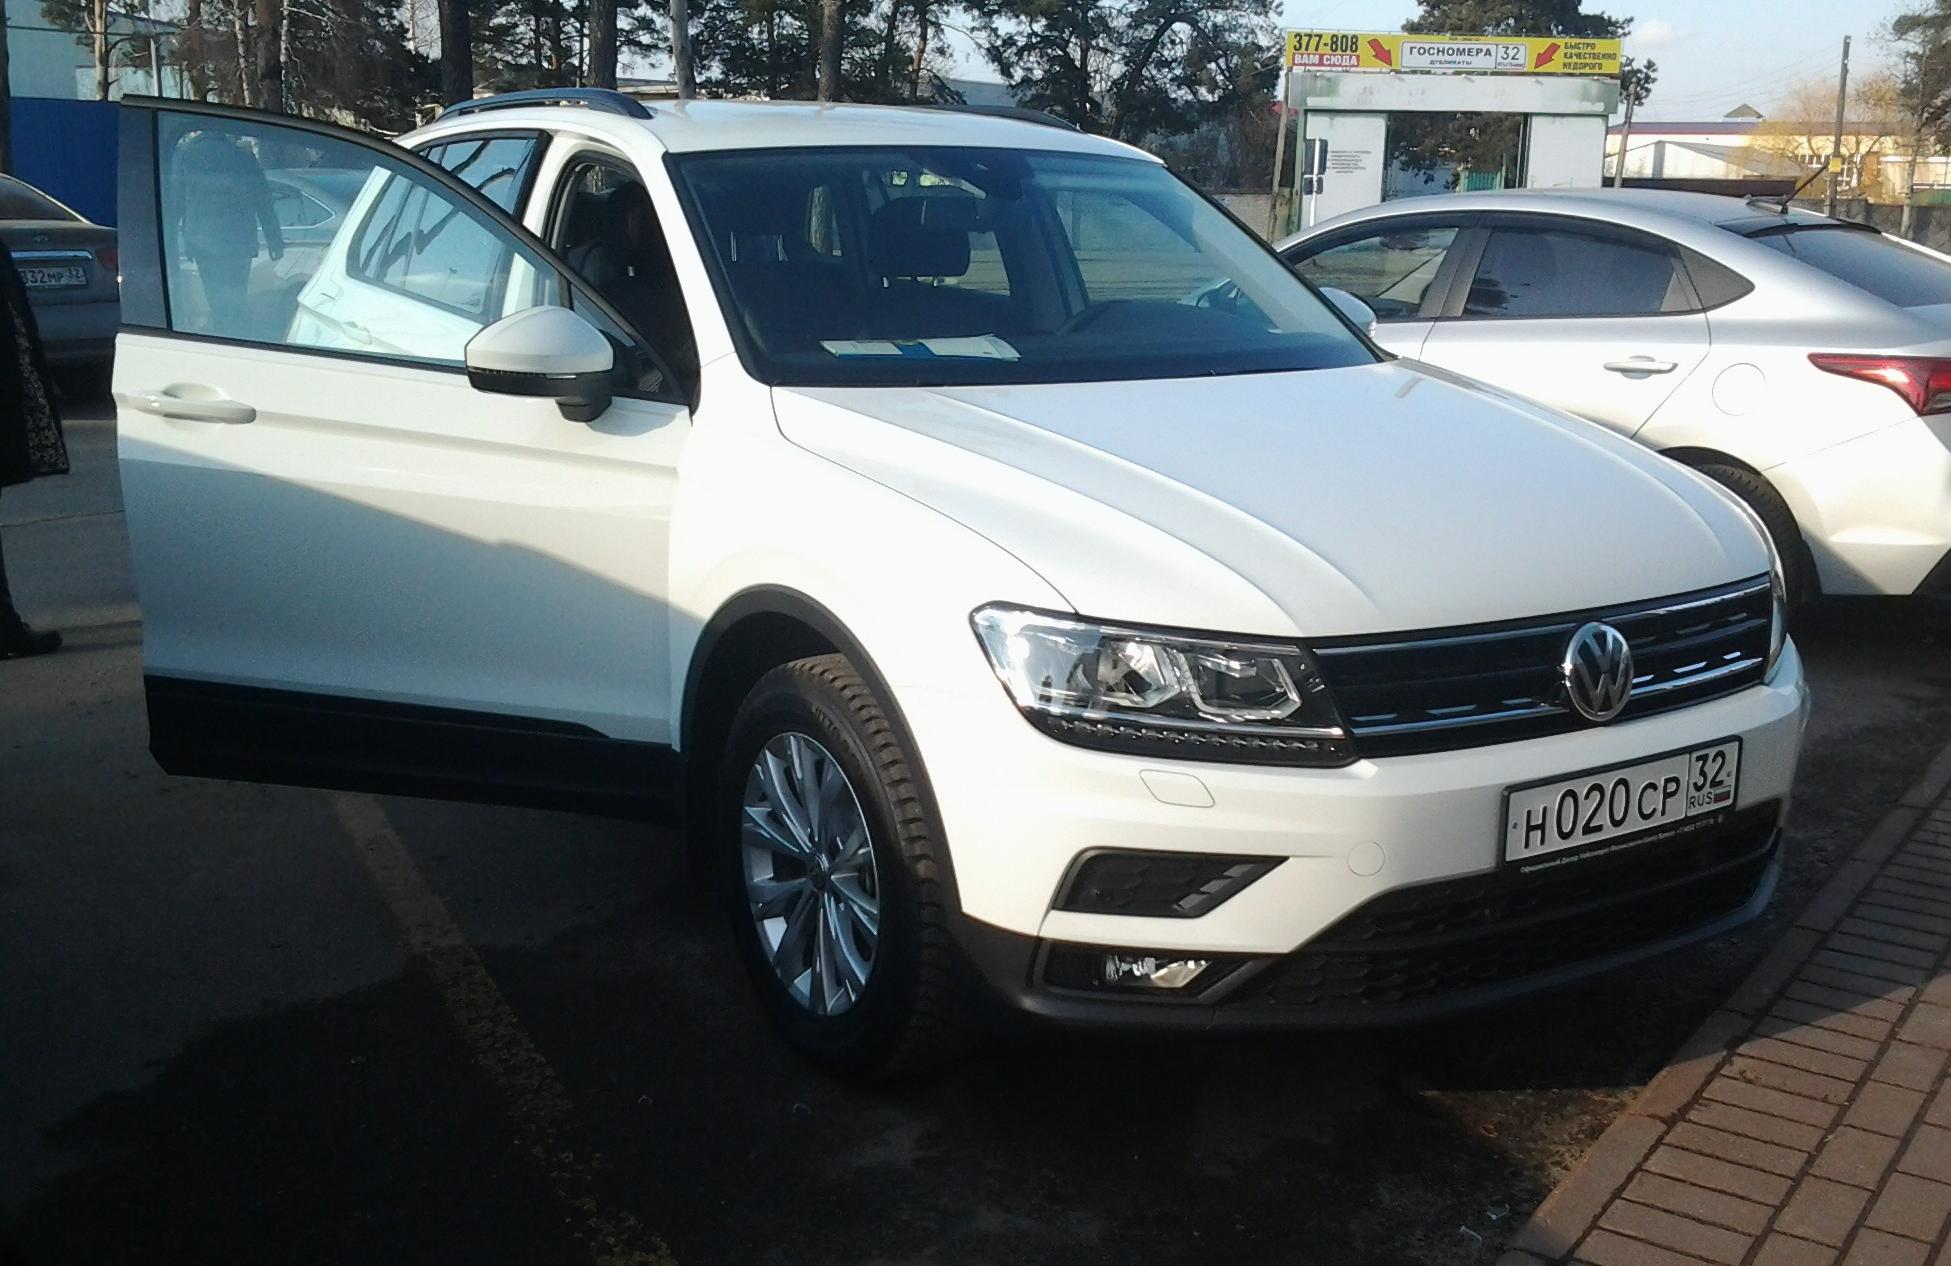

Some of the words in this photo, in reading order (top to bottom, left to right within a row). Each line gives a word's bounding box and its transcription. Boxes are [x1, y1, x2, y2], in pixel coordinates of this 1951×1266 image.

[1293, 32, 1359, 53] 377-808
[1564, 41, 1596, 51] БЫСТРО
[1409, 46, 1492, 57] ГОСНОМЕРА
[1500, 46, 1521, 61] 32
[1563, 51, 1617, 61] КАЧЕСТВЕННО
[1294, 54, 1319, 65] ВАМ
[1323, 55, 1358, 66] СЮДА
[1562, 62, 1603, 71] НЕДОРОГО
[1692, 749, 1727, 793] 32
[1688, 790, 1714, 809] RUS
